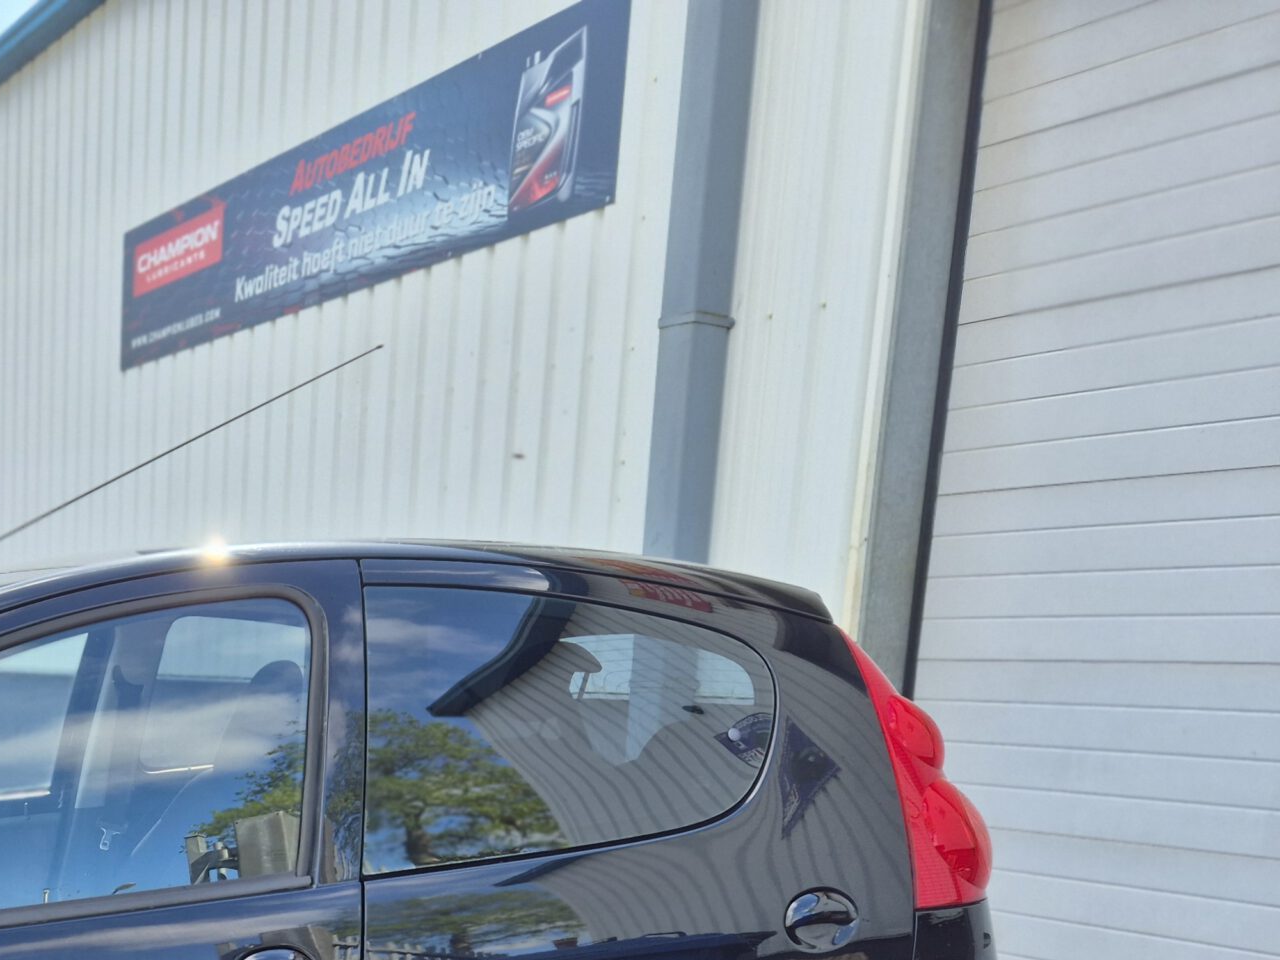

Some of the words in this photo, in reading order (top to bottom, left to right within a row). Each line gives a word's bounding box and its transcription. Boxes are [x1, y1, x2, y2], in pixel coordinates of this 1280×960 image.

[288, 111, 417, 197] AUTOBEDRIJF
[272, 188, 342, 248] SPEED
[344, 166, 389, 219] ALL
[397, 148, 431, 197] IN
[137, 219, 220, 273] CHAMPION
[235, 256, 299, 302] Kwaliteit
[301, 236, 346, 274] hoeft
